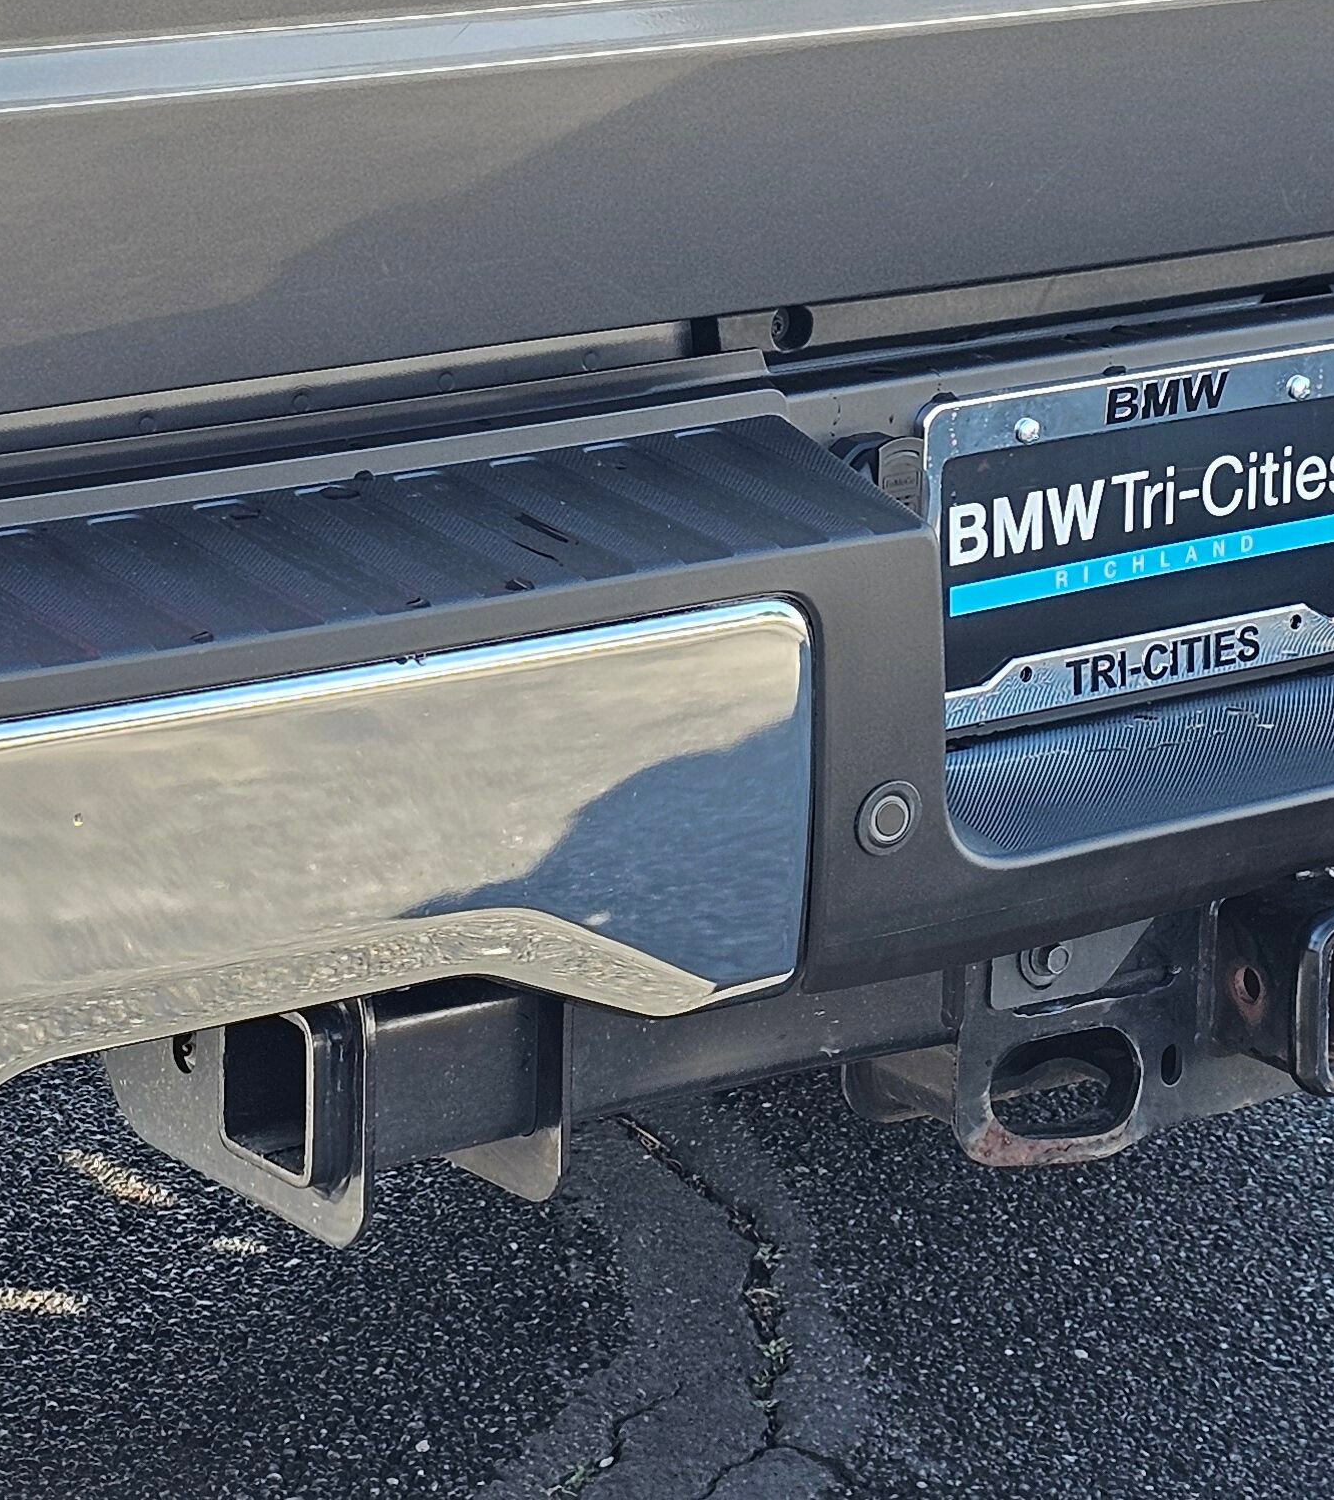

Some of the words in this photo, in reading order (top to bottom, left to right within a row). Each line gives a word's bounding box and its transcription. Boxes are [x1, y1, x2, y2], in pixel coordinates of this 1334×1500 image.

[1105, 369, 1230, 425] BMW
[948, 480, 1104, 567] BMW
[1054, 534, 1255, 590] RICHLAND
[1065, 626, 1260, 696] TRI-CITIES
